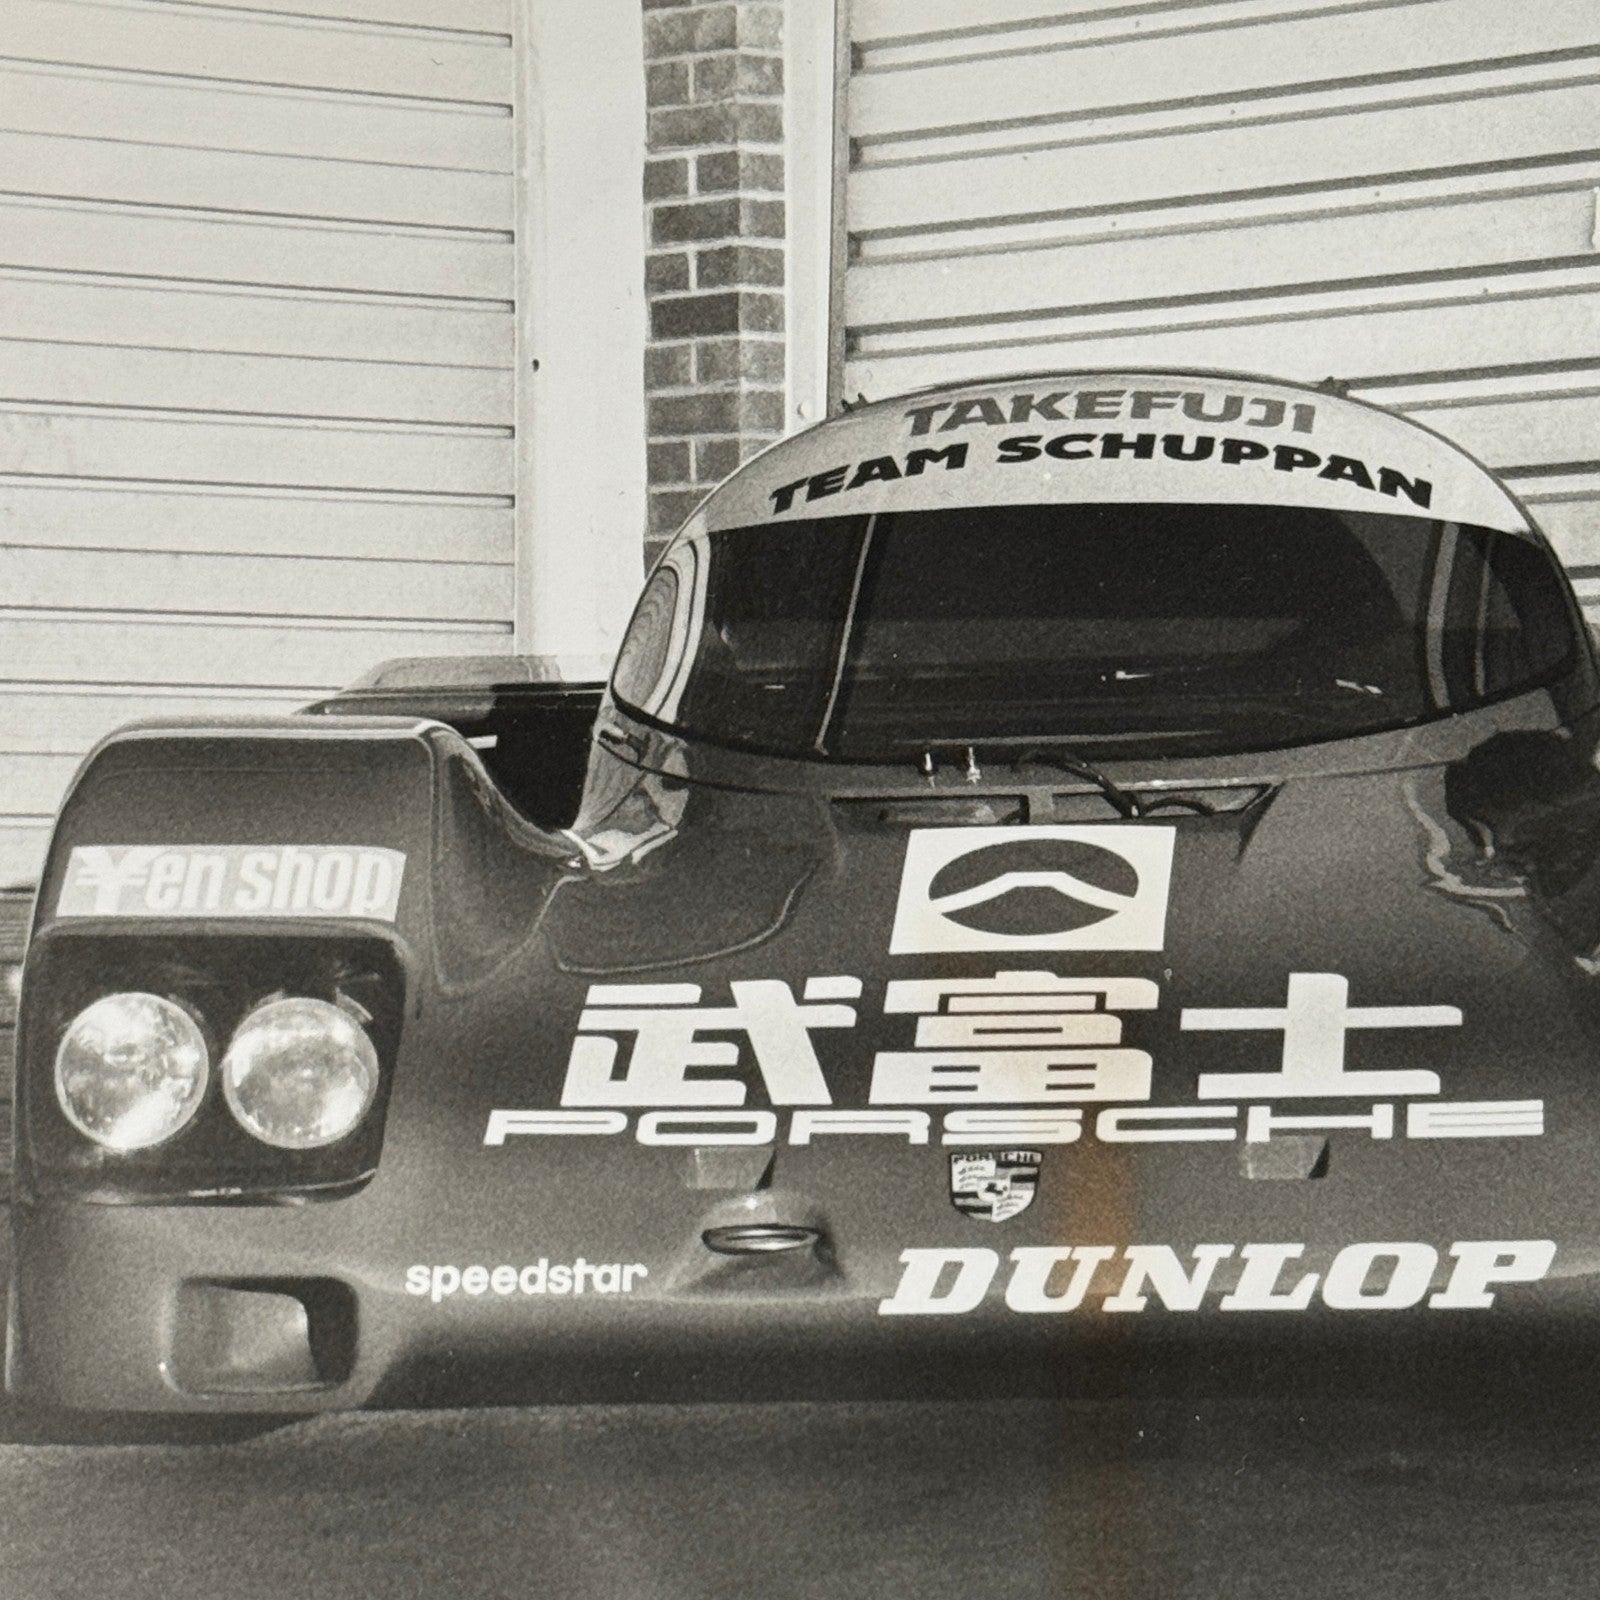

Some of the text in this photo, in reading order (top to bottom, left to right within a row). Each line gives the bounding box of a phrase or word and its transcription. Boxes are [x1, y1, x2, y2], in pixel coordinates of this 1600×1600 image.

[903, 389, 1317, 434] TAKEFUJI
[769, 433, 1433, 515] TEAM SCHUPPAN
[234, 846, 397, 922] shop
[559, 971, 1464, 1106] 武富士
[483, 1100, 1545, 1146] PORSCHE
[404, 1257, 649, 1303] speedstar
[879, 1239, 1558, 1315] DUNLOP
